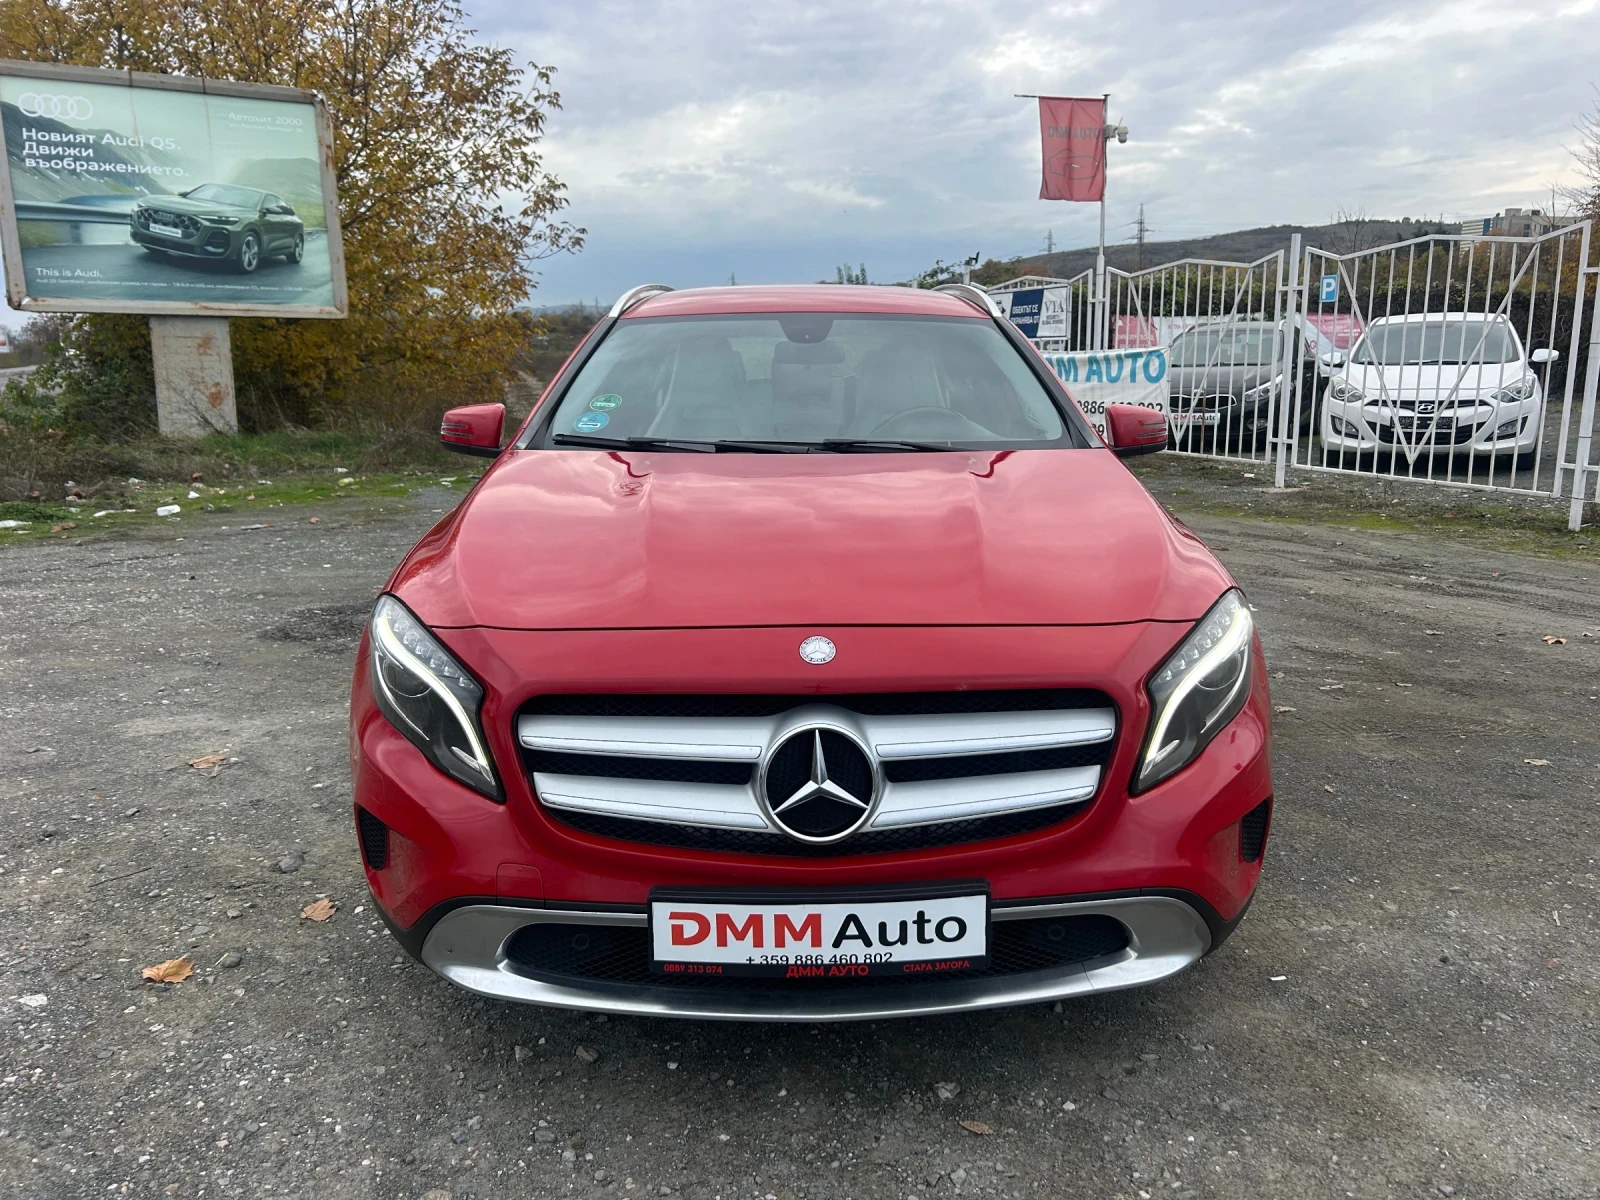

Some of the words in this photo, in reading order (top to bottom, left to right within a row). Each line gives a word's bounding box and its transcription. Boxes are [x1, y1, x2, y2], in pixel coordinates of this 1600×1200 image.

[275, 116, 303, 127] 2000
[22, 127, 96, 144] Новият
[101, 132, 144, 147] Audi
[150, 136, 182, 150] Q5.
[22, 141, 94, 157] Движи
[24, 157, 189, 177] въображението.
[35, 267, 60, 277] This
[62, 268, 72, 277] is
[74, 268, 103, 278] Audi.
[1322, 278, 1336, 300] P
[1044, 300, 1065, 313] VIA
[1085, 350, 1166, 384] AUTO
[794, 954, 824, 964] 886
[828, 953, 858, 964] 460
[863, 952, 893, 963] 802
[663, 963, 685, 973] 0889
[687, 964, 704, 973] 313
[705, 965, 723, 974] 074
[786, 965, 825, 979] ДММ
[828, 965, 869, 977] АУТО
[903, 962, 933, 973] СТАРА
[935, 960, 970, 970] ЗАГОРА
